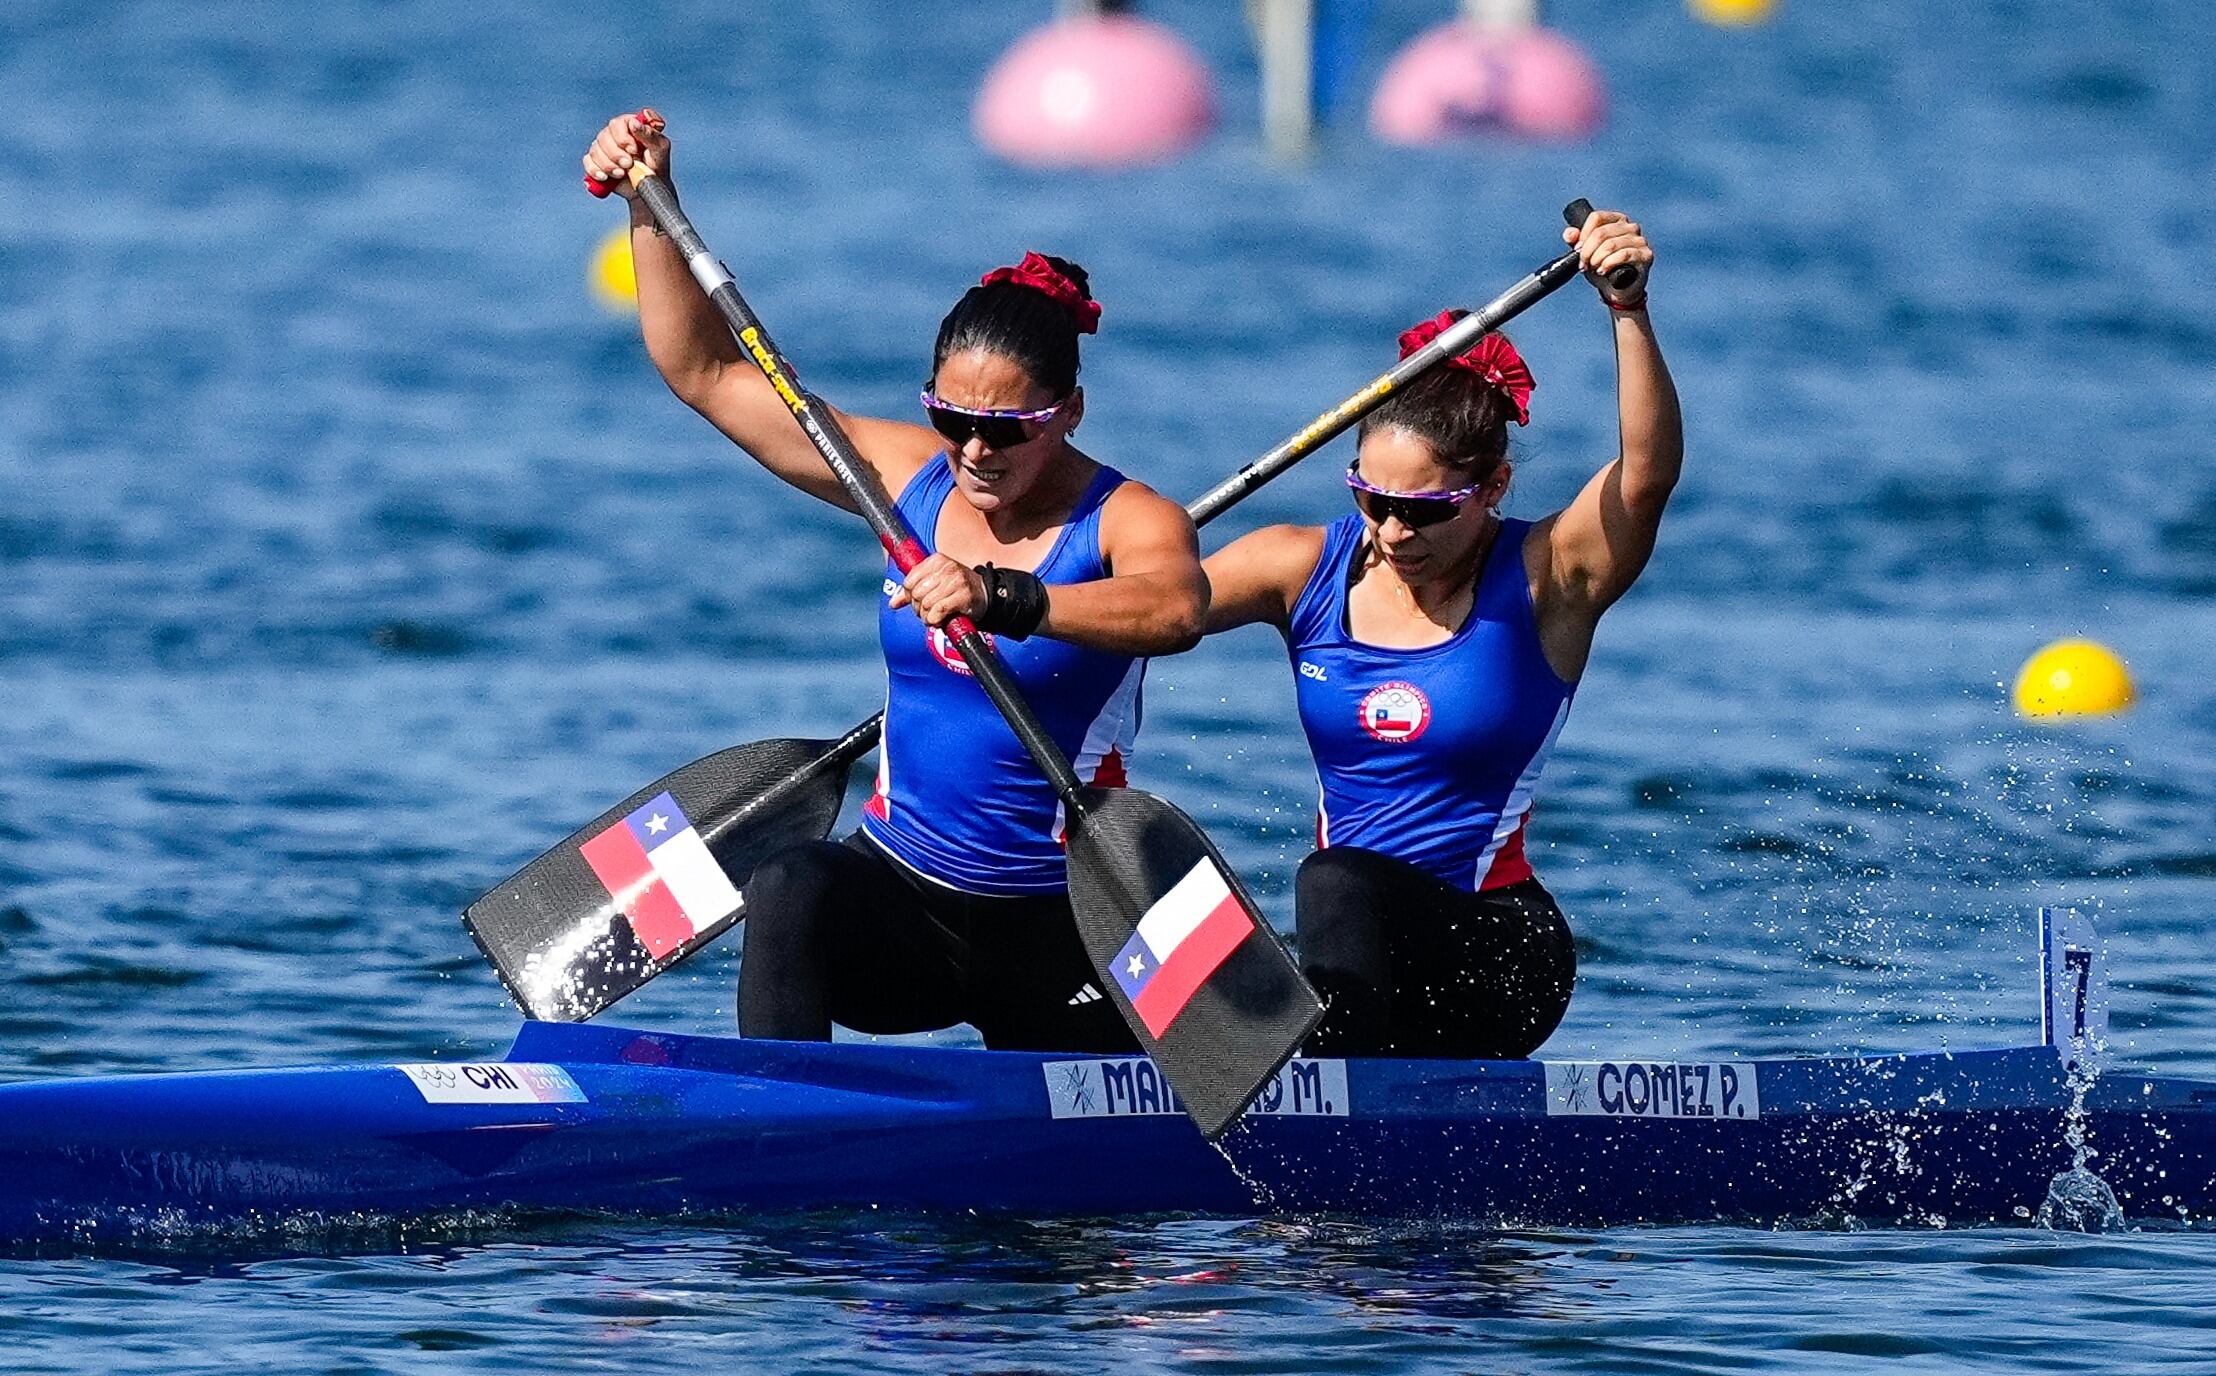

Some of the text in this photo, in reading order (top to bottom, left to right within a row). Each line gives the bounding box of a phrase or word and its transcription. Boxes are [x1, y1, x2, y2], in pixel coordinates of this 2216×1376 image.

[2065, 950, 2092, 1038] 7
[461, 1066, 519, 1089] CHI
[530, 1076, 573, 1089] 2024
[1291, 1061, 1333, 1114] M.
[1598, 1063, 1745, 1118] GOMEZ P.
